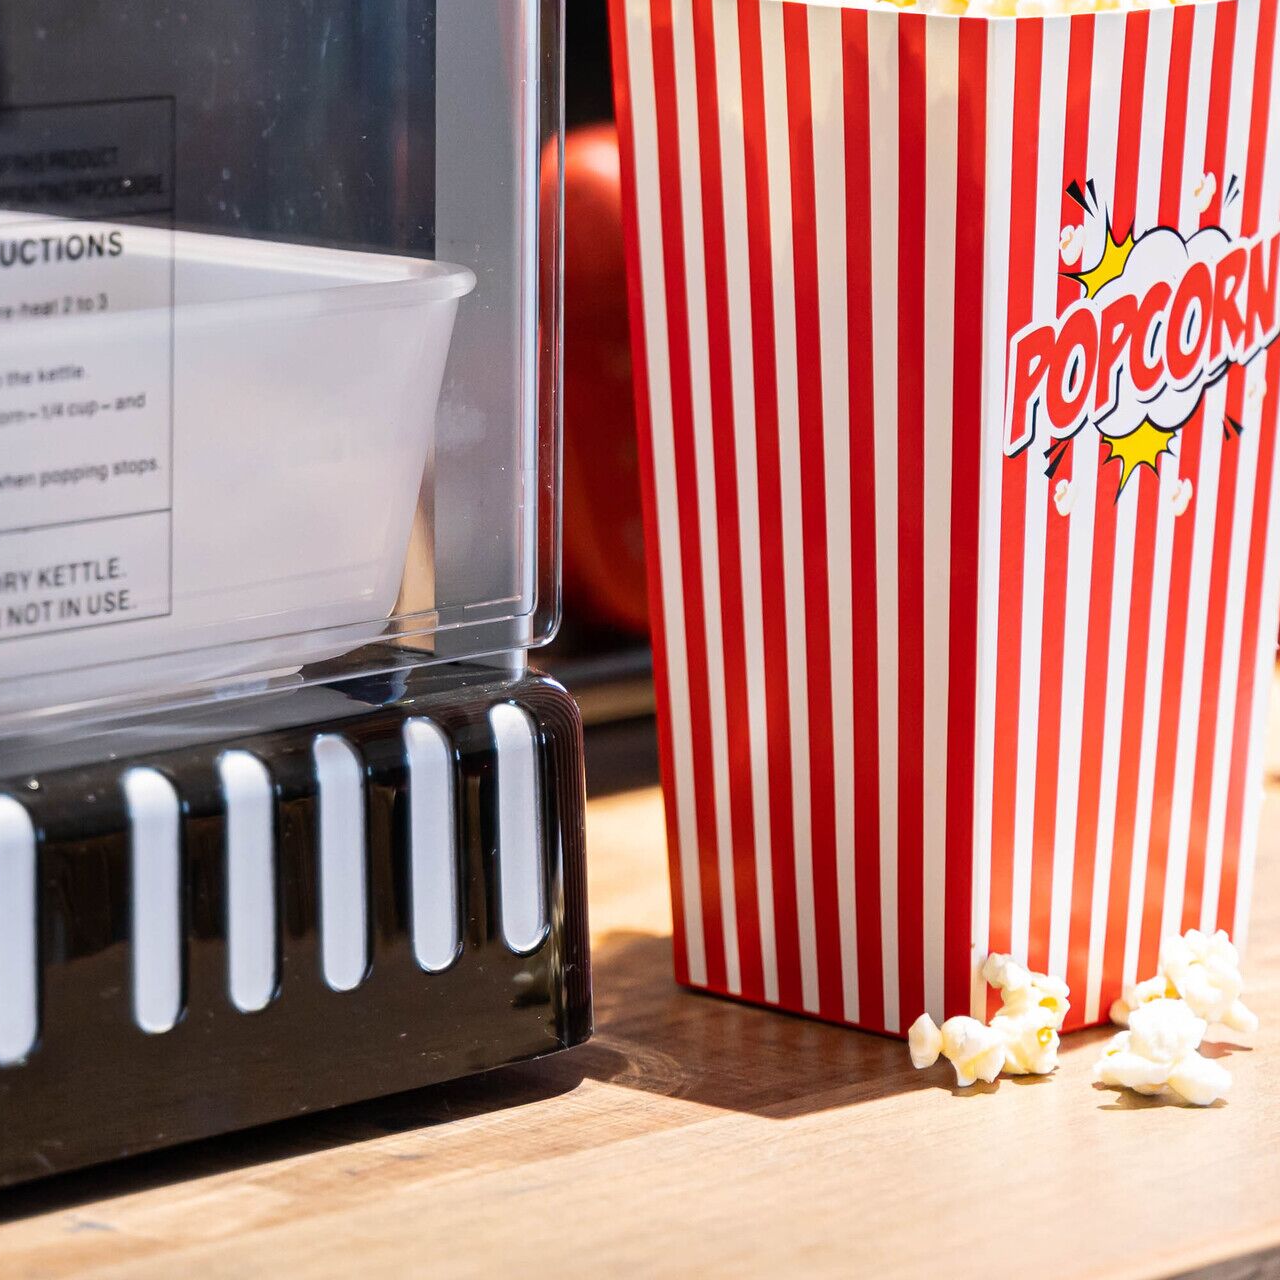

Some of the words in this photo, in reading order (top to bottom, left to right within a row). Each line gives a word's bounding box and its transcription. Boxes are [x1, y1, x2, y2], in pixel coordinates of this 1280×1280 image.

[62, 296, 73, 313] 2
[76, 296, 94, 312] to
[97, 292, 109, 311] 3
[6, 370, 34, 388] the
[115, 391, 147, 412] and
[39, 464, 111, 489] popping
[36, 557, 127, 590] KETTLE.
[6, 598, 54, 626] NOT
[58, 595, 82, 619] IN
